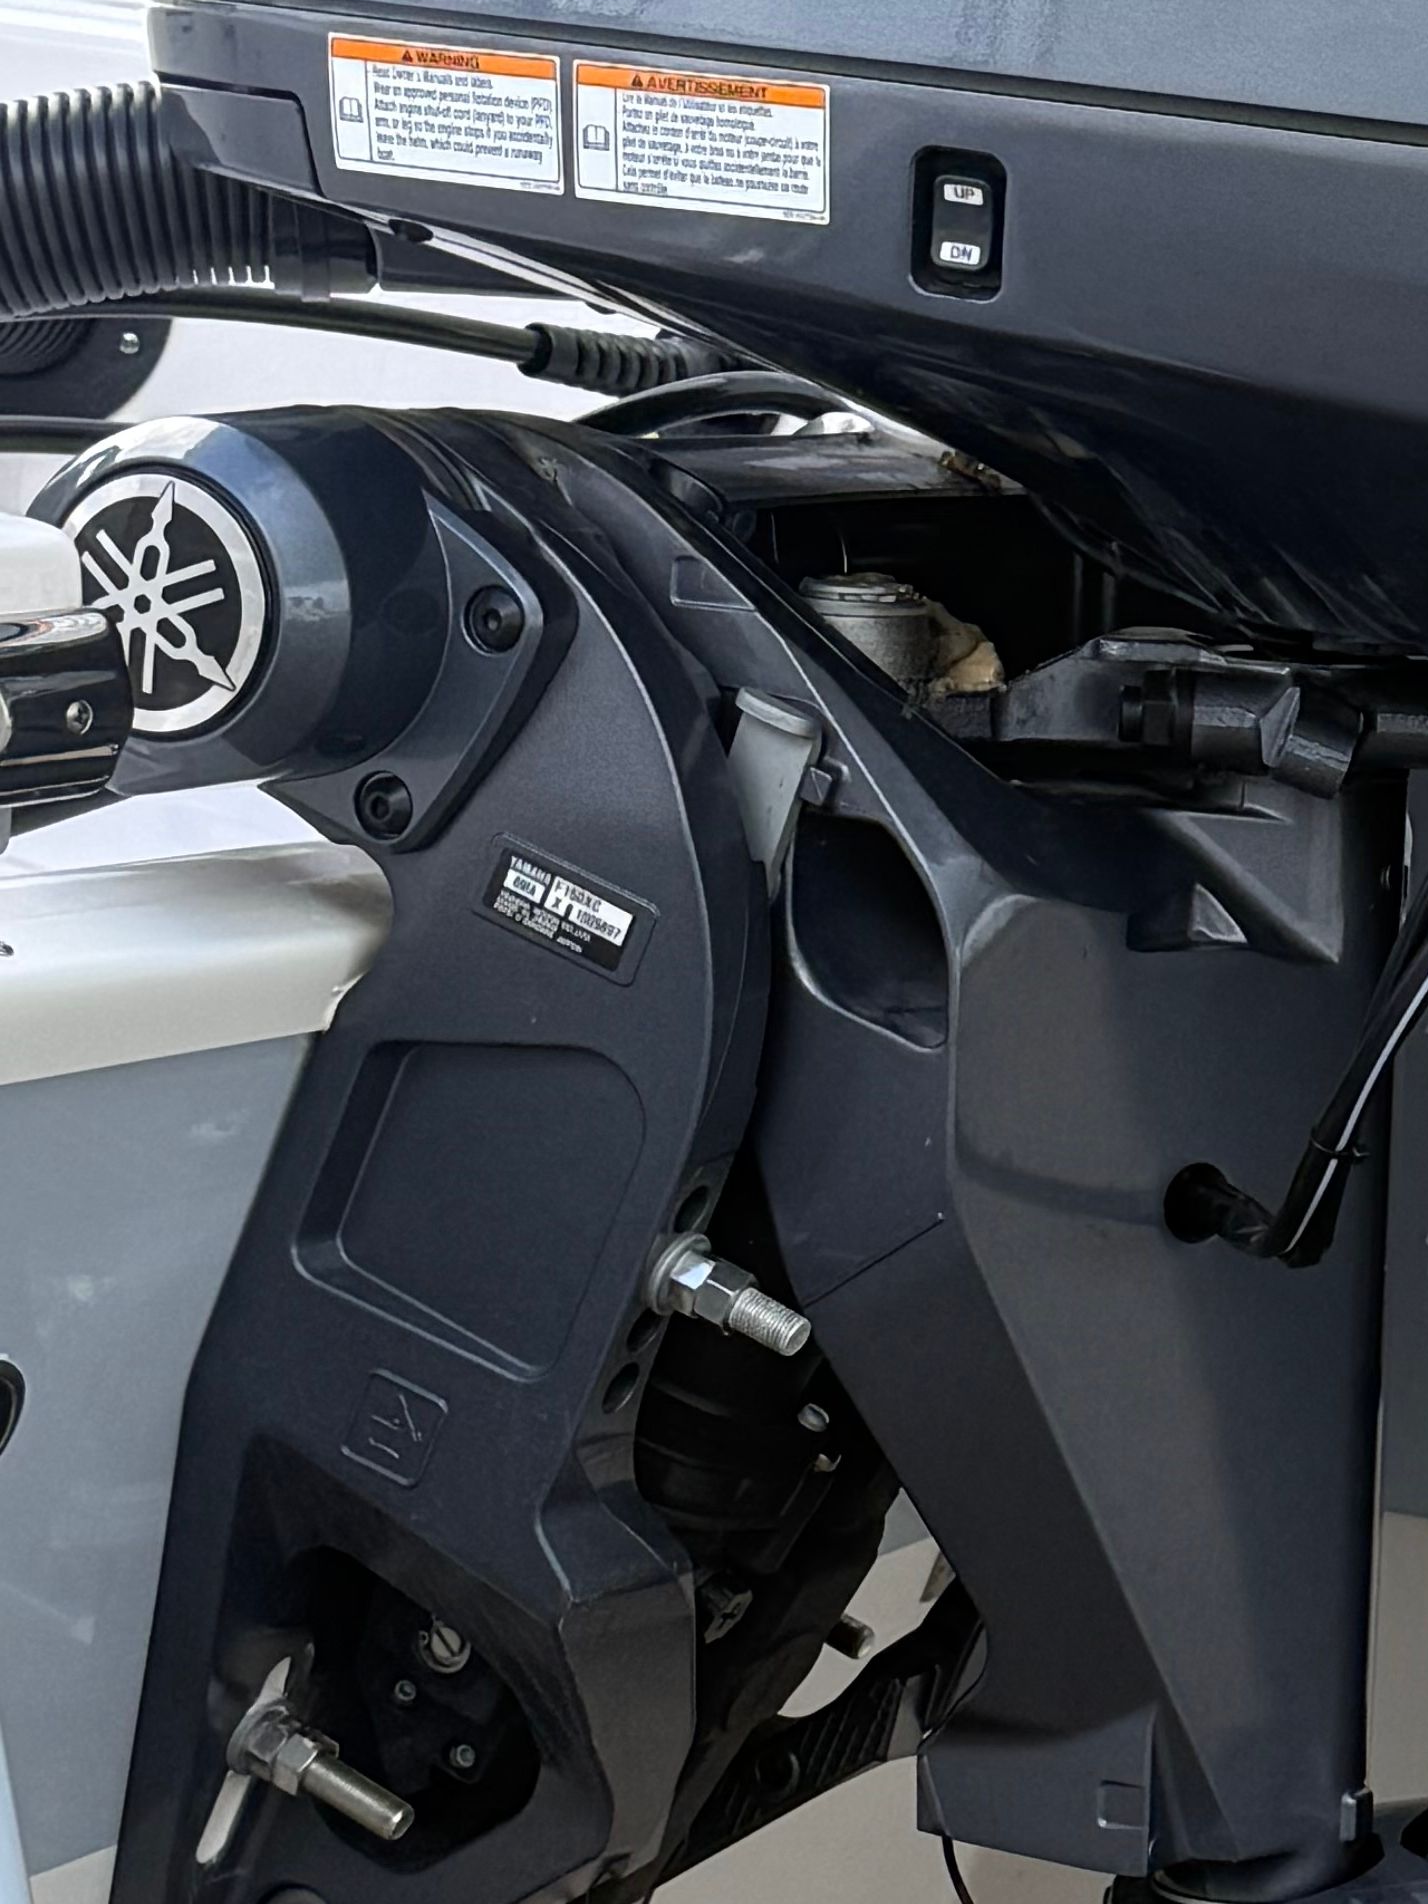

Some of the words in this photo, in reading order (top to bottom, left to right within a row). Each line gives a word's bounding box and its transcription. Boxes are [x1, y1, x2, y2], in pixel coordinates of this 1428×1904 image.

[416, 50, 480, 69] WARNING
[647, 75, 767, 98] AVERTISSEMENT
[953, 186, 975, 201] UP
[950, 245, 973, 262] DN
